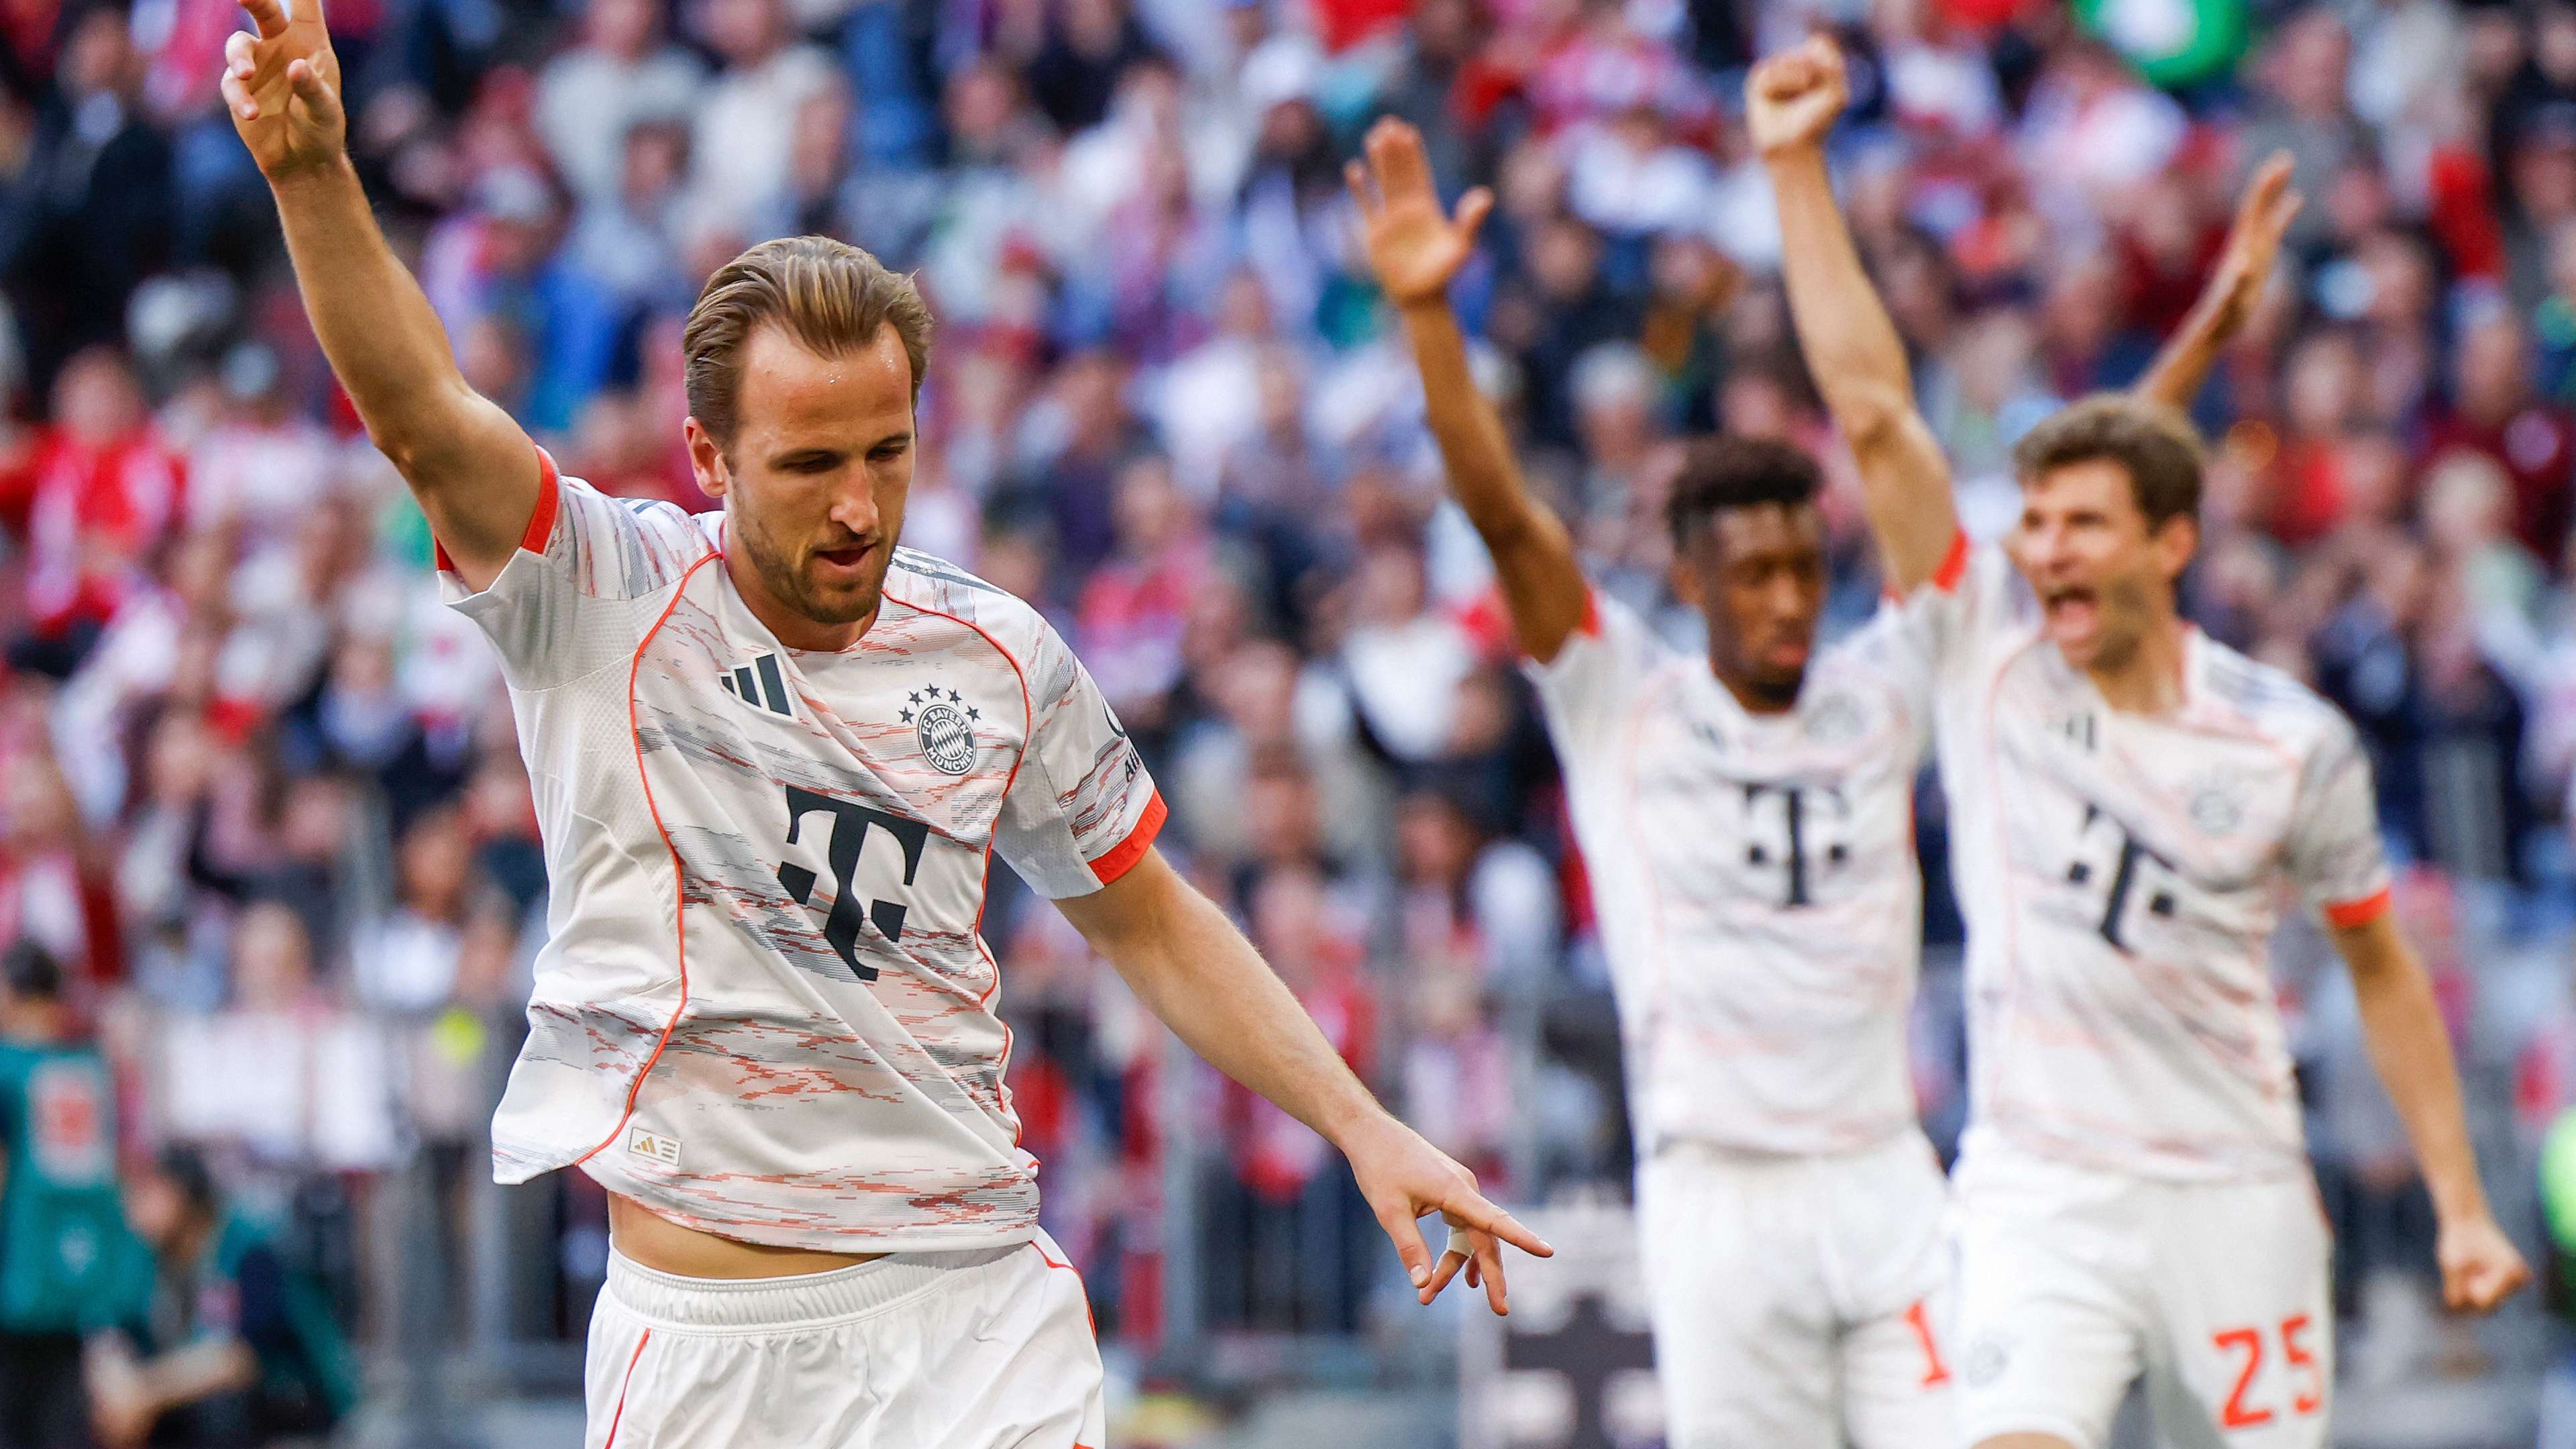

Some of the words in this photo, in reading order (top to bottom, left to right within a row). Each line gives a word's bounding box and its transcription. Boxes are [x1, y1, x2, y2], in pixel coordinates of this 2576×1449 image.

[922, 719, 932, 735] FC
[929, 709, 969, 734] BAYERN
[2212, 1313, 2323, 1428] 25
